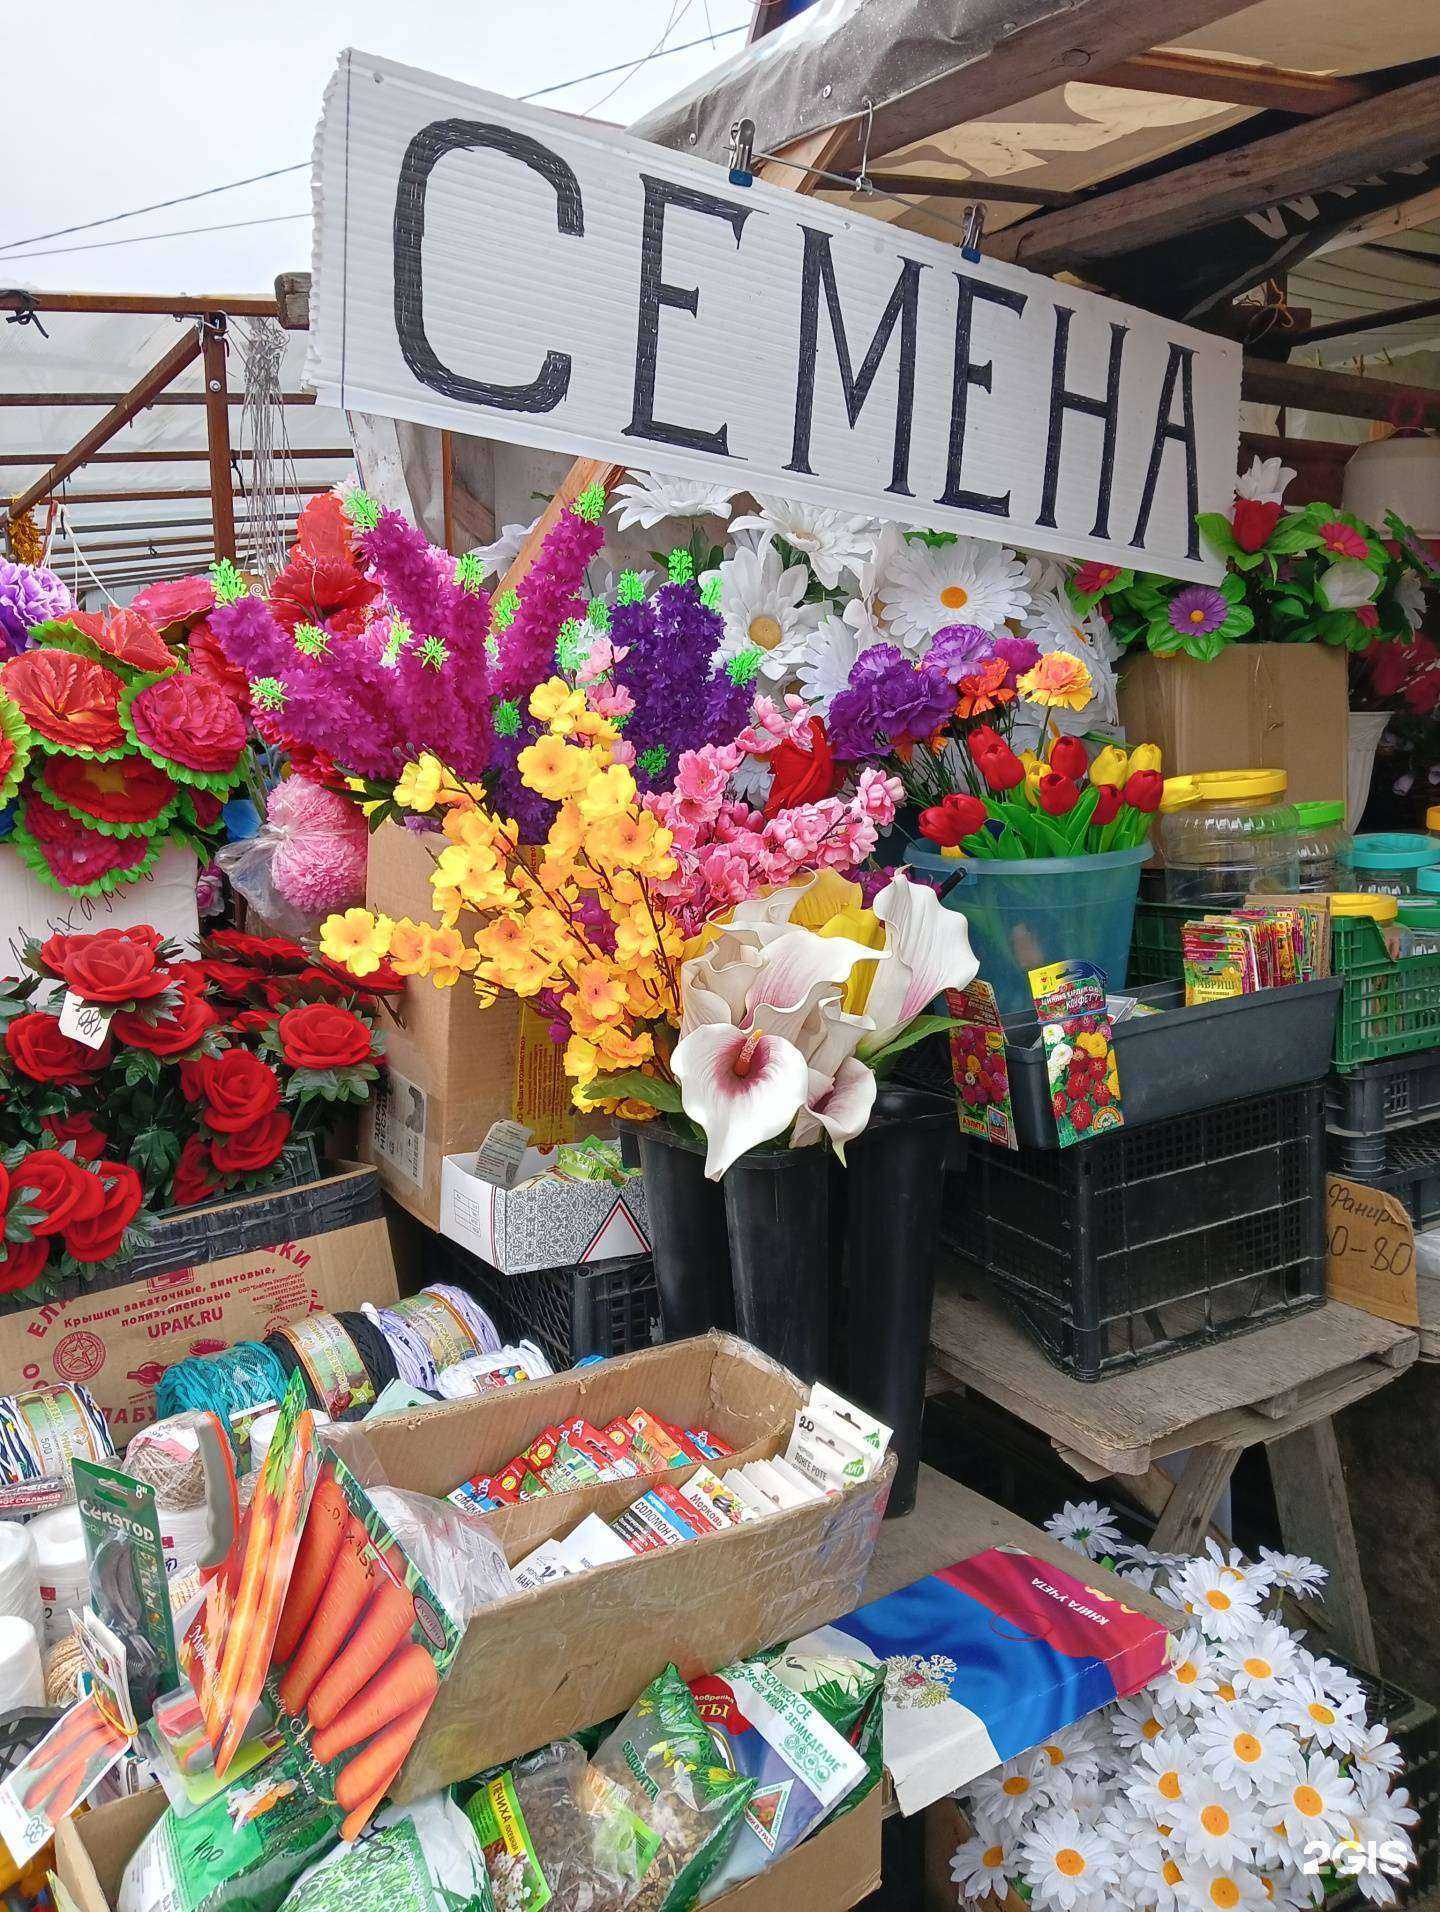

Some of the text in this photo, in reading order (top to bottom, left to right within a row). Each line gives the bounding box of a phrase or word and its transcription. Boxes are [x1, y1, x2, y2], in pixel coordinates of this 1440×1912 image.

[394, 117, 1204, 561] СЕМЕНА
[64, 1266, 276, 1329] Крышки закаточные, винтовые,
[147, 1307, 223, 1339] UPAK.RU
[798, 1416, 815, 1432] 20
[635, 1501, 670, 1536] СОЛОМОН
[690, 1493, 723, 1527] Морковь
[515, 1574, 535, 1590] НАНТ
[1031, 1577, 1110, 1625] КНИГА УЧЕТА
[784, 1712, 842, 1773] ЗЕМЛЕДЕЛИЕ
